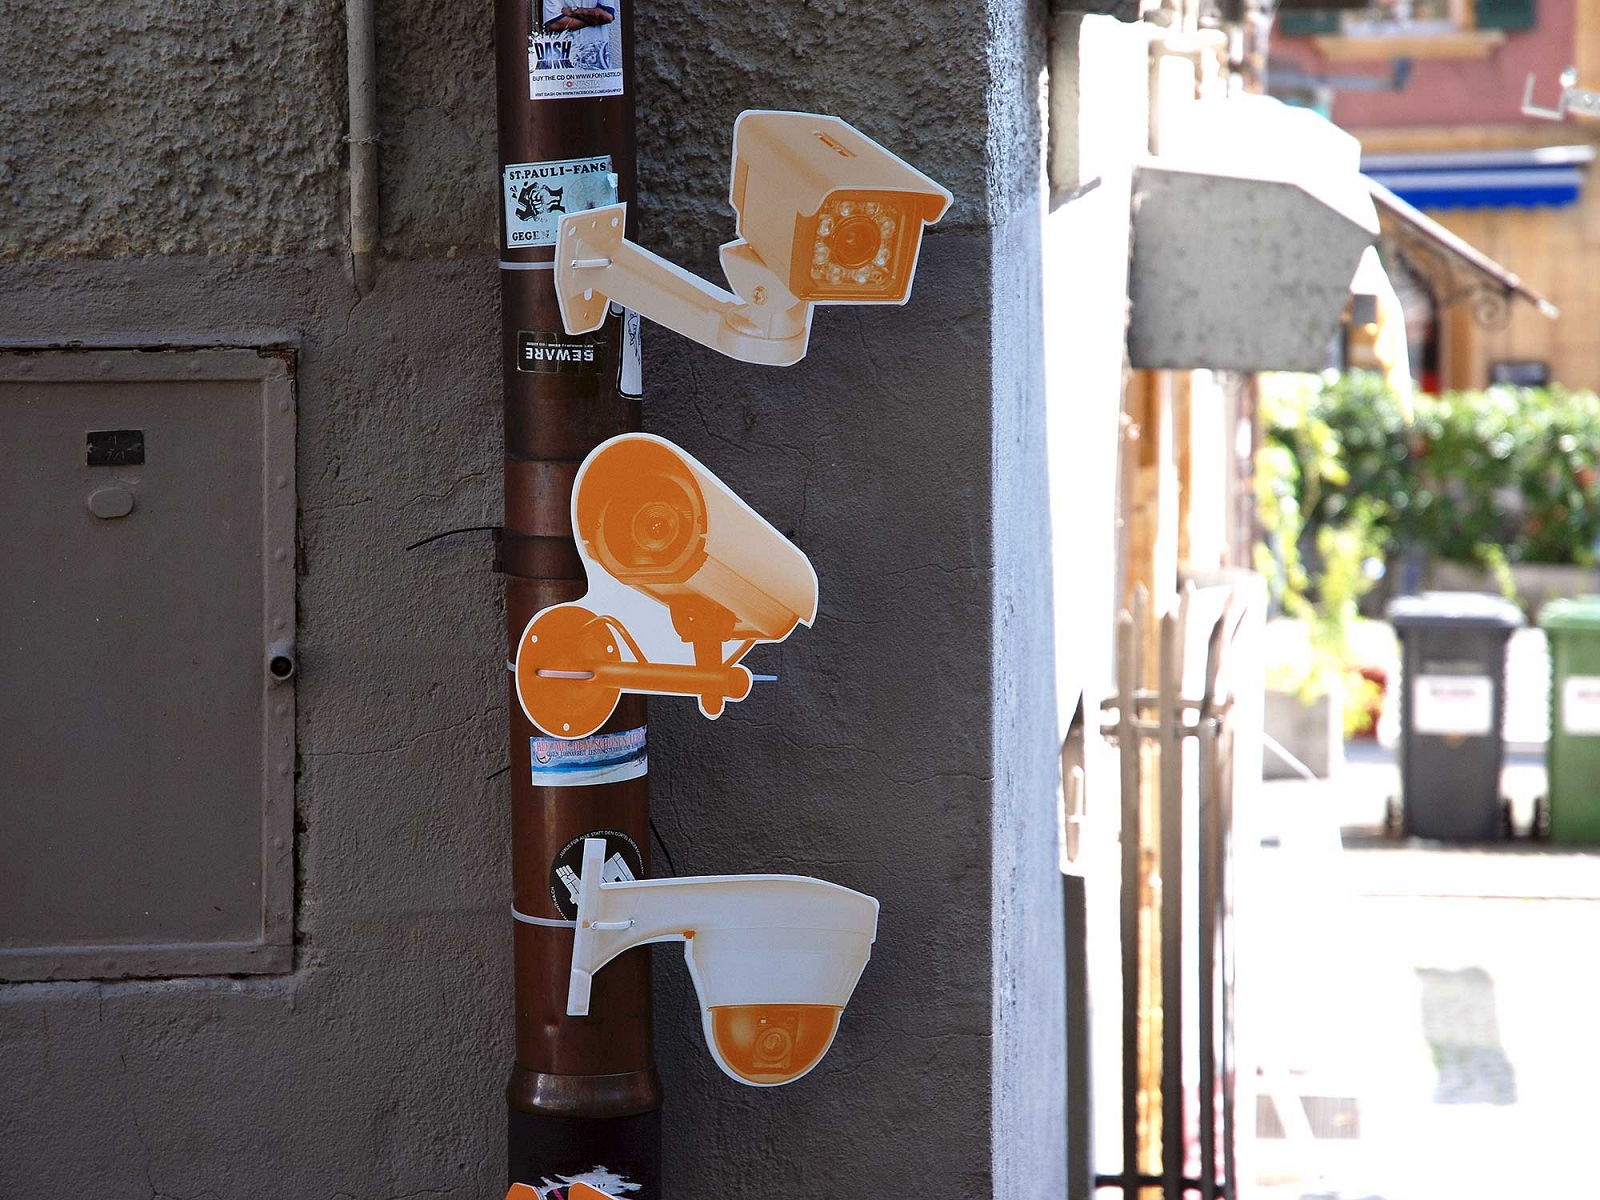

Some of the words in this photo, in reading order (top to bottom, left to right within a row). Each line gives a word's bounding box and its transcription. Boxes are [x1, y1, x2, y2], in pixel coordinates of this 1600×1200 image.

[534, 41, 572, 60] DASH
[509, 162, 607, 180] ST.PAULI-FANS
[525, 347, 594, 361] BEWARE
[574, 739, 592, 751] DEM
